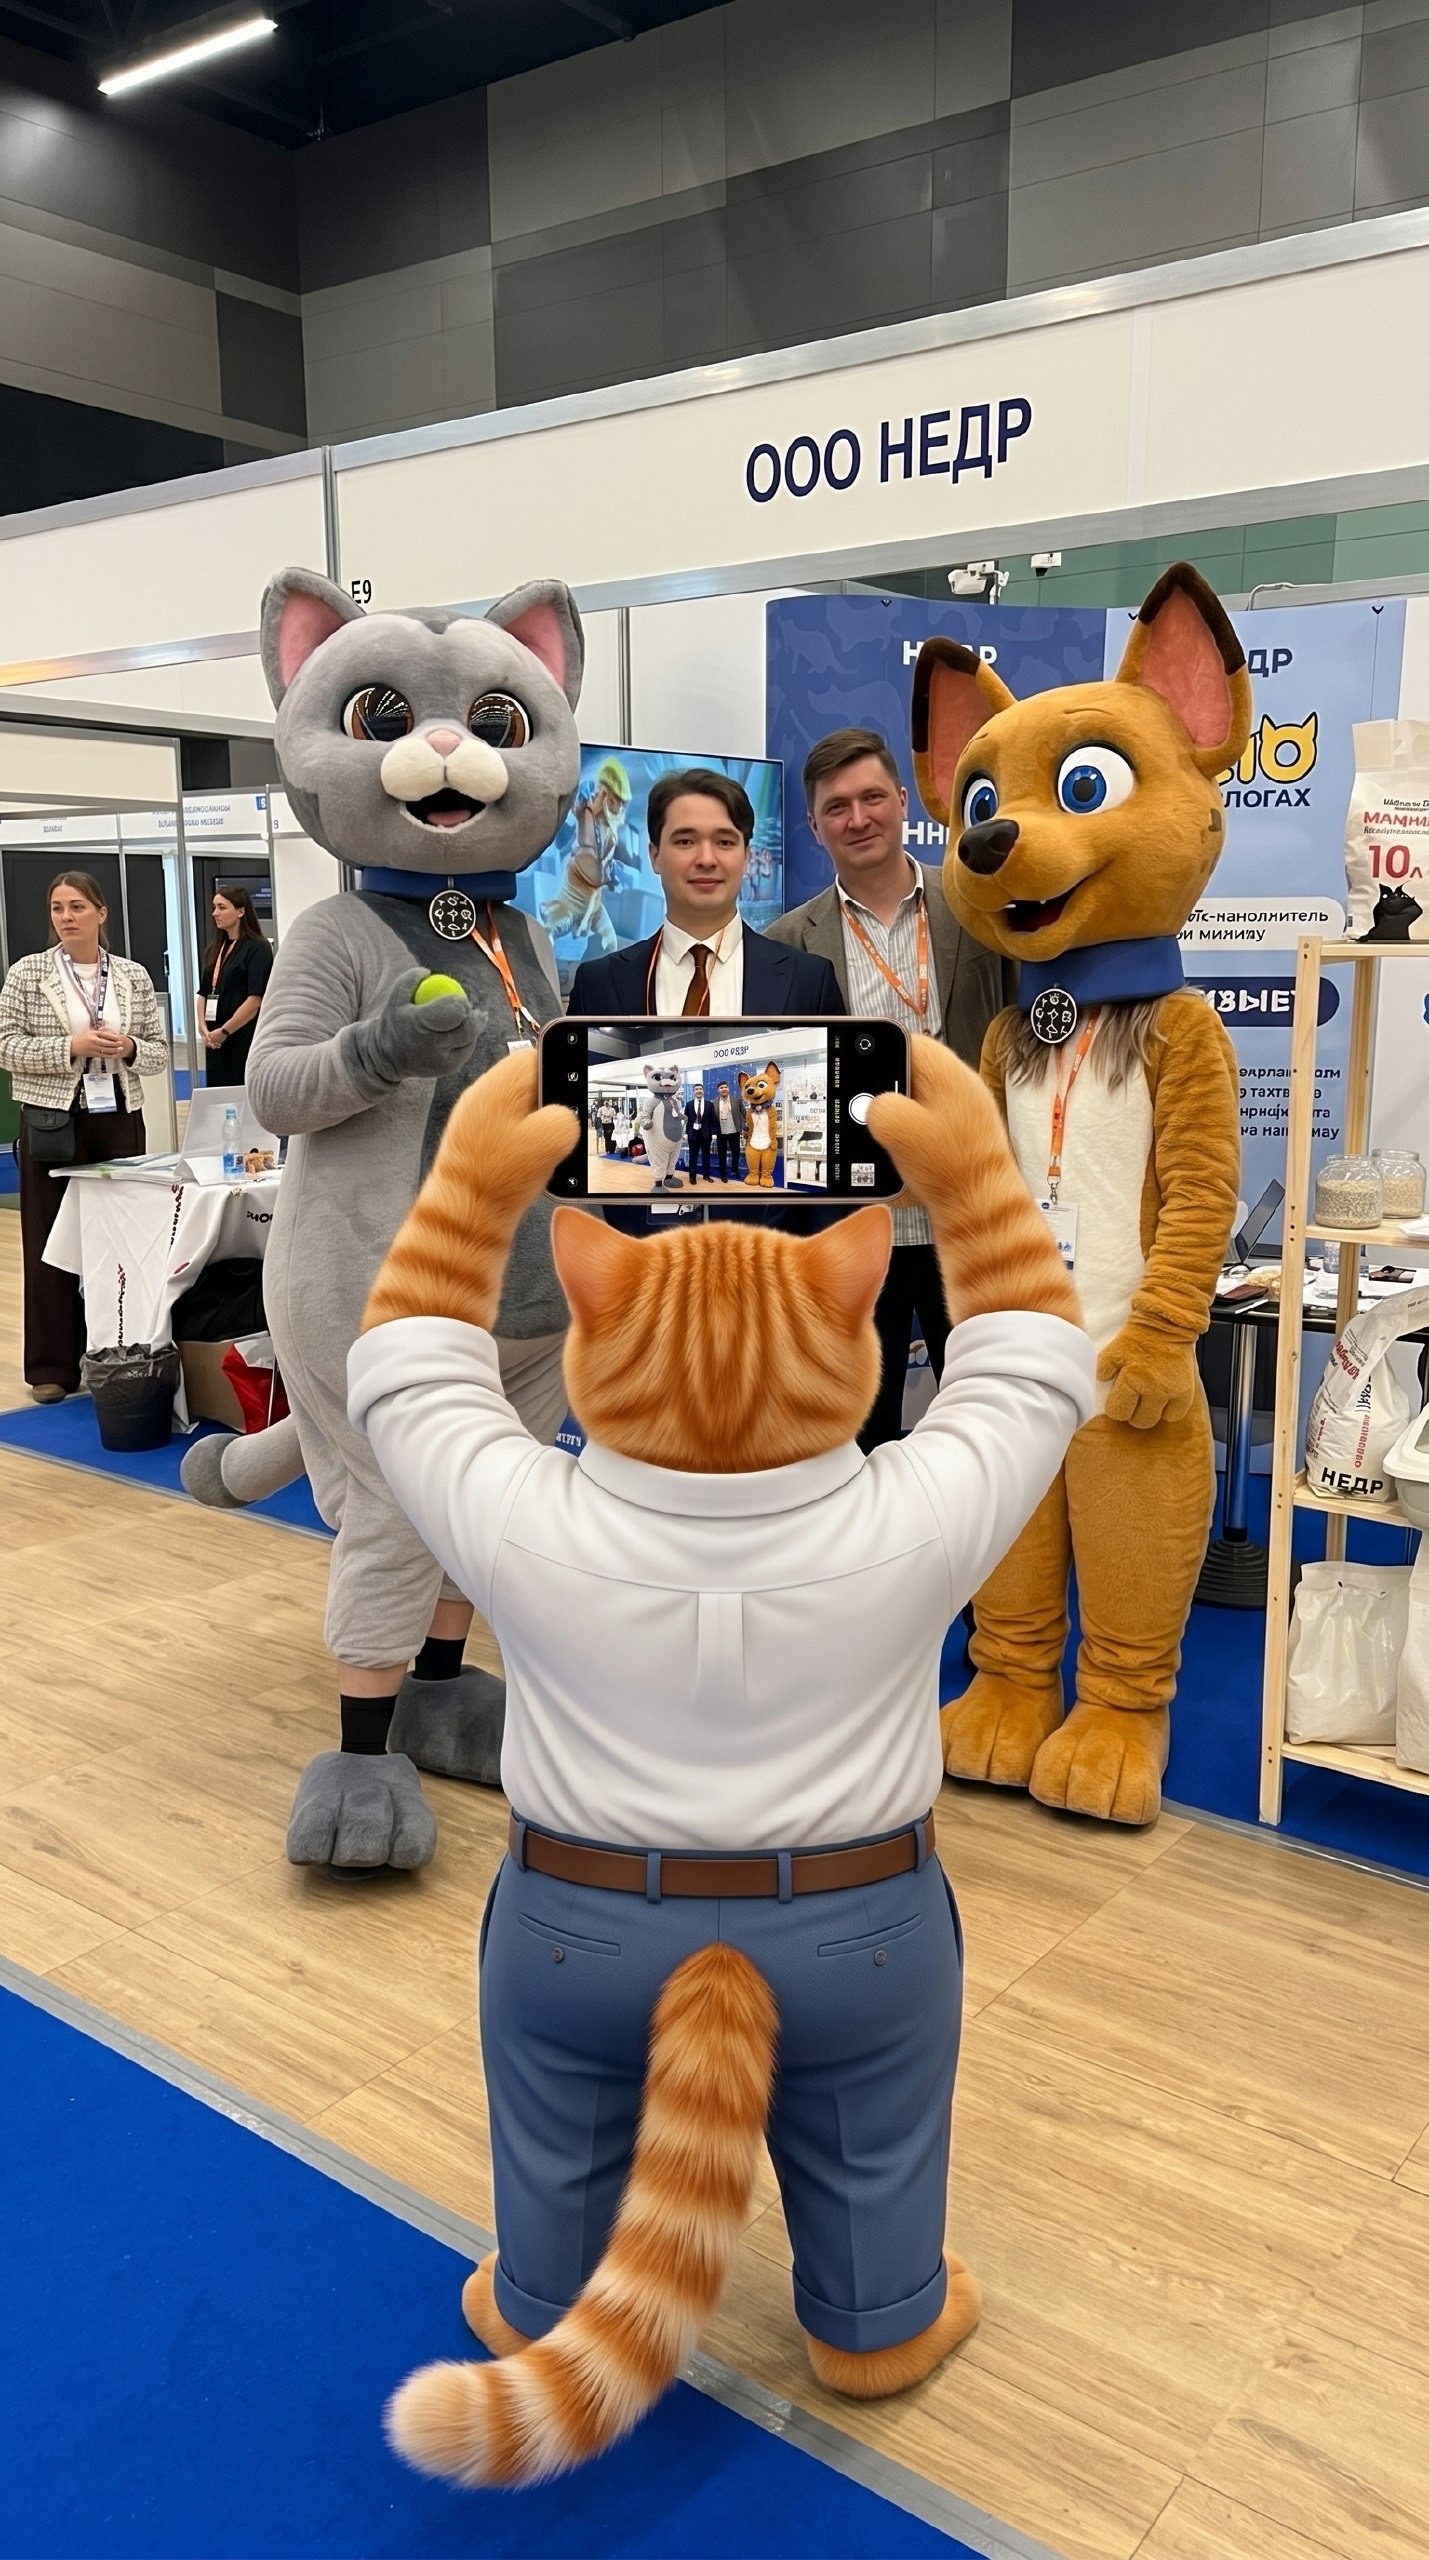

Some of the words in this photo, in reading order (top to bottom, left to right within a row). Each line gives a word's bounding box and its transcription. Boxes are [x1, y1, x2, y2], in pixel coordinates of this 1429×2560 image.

[746, 428, 861, 503] ООО
[880, 397, 1032, 484] НЕДР
[1221, 788, 1311, 808] ЛОГАХ
[1321, 1467, 1384, 1494] НЕДР
